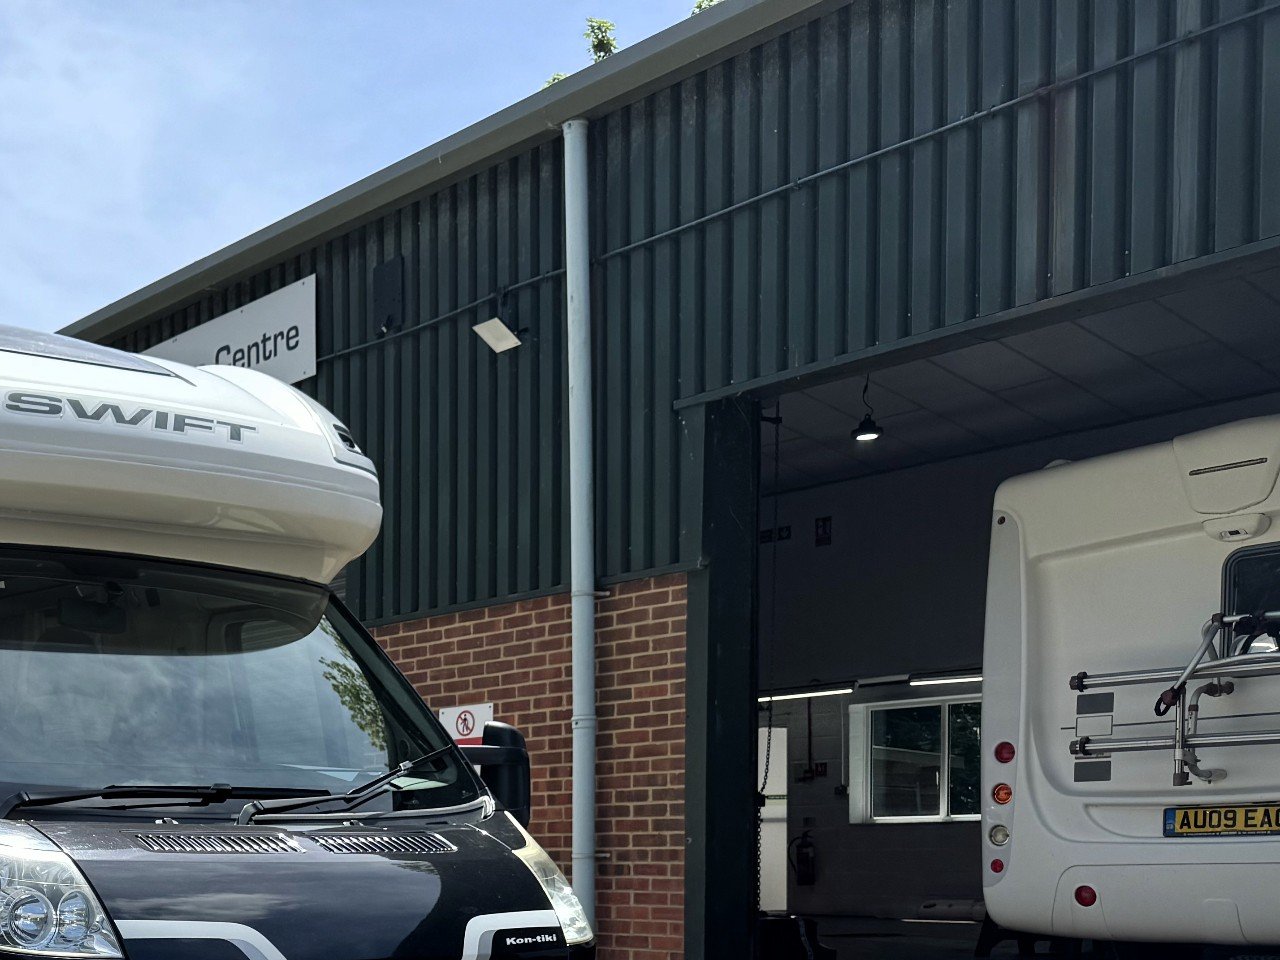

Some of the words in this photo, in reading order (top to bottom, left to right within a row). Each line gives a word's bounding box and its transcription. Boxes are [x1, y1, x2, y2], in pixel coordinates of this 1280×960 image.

[215, 325, 299, 368] Centre
[5, 392, 257, 441] SWIFT
[1179, 809, 1237, 829] AU09
[506, 933, 557, 946] Kon-tiki
